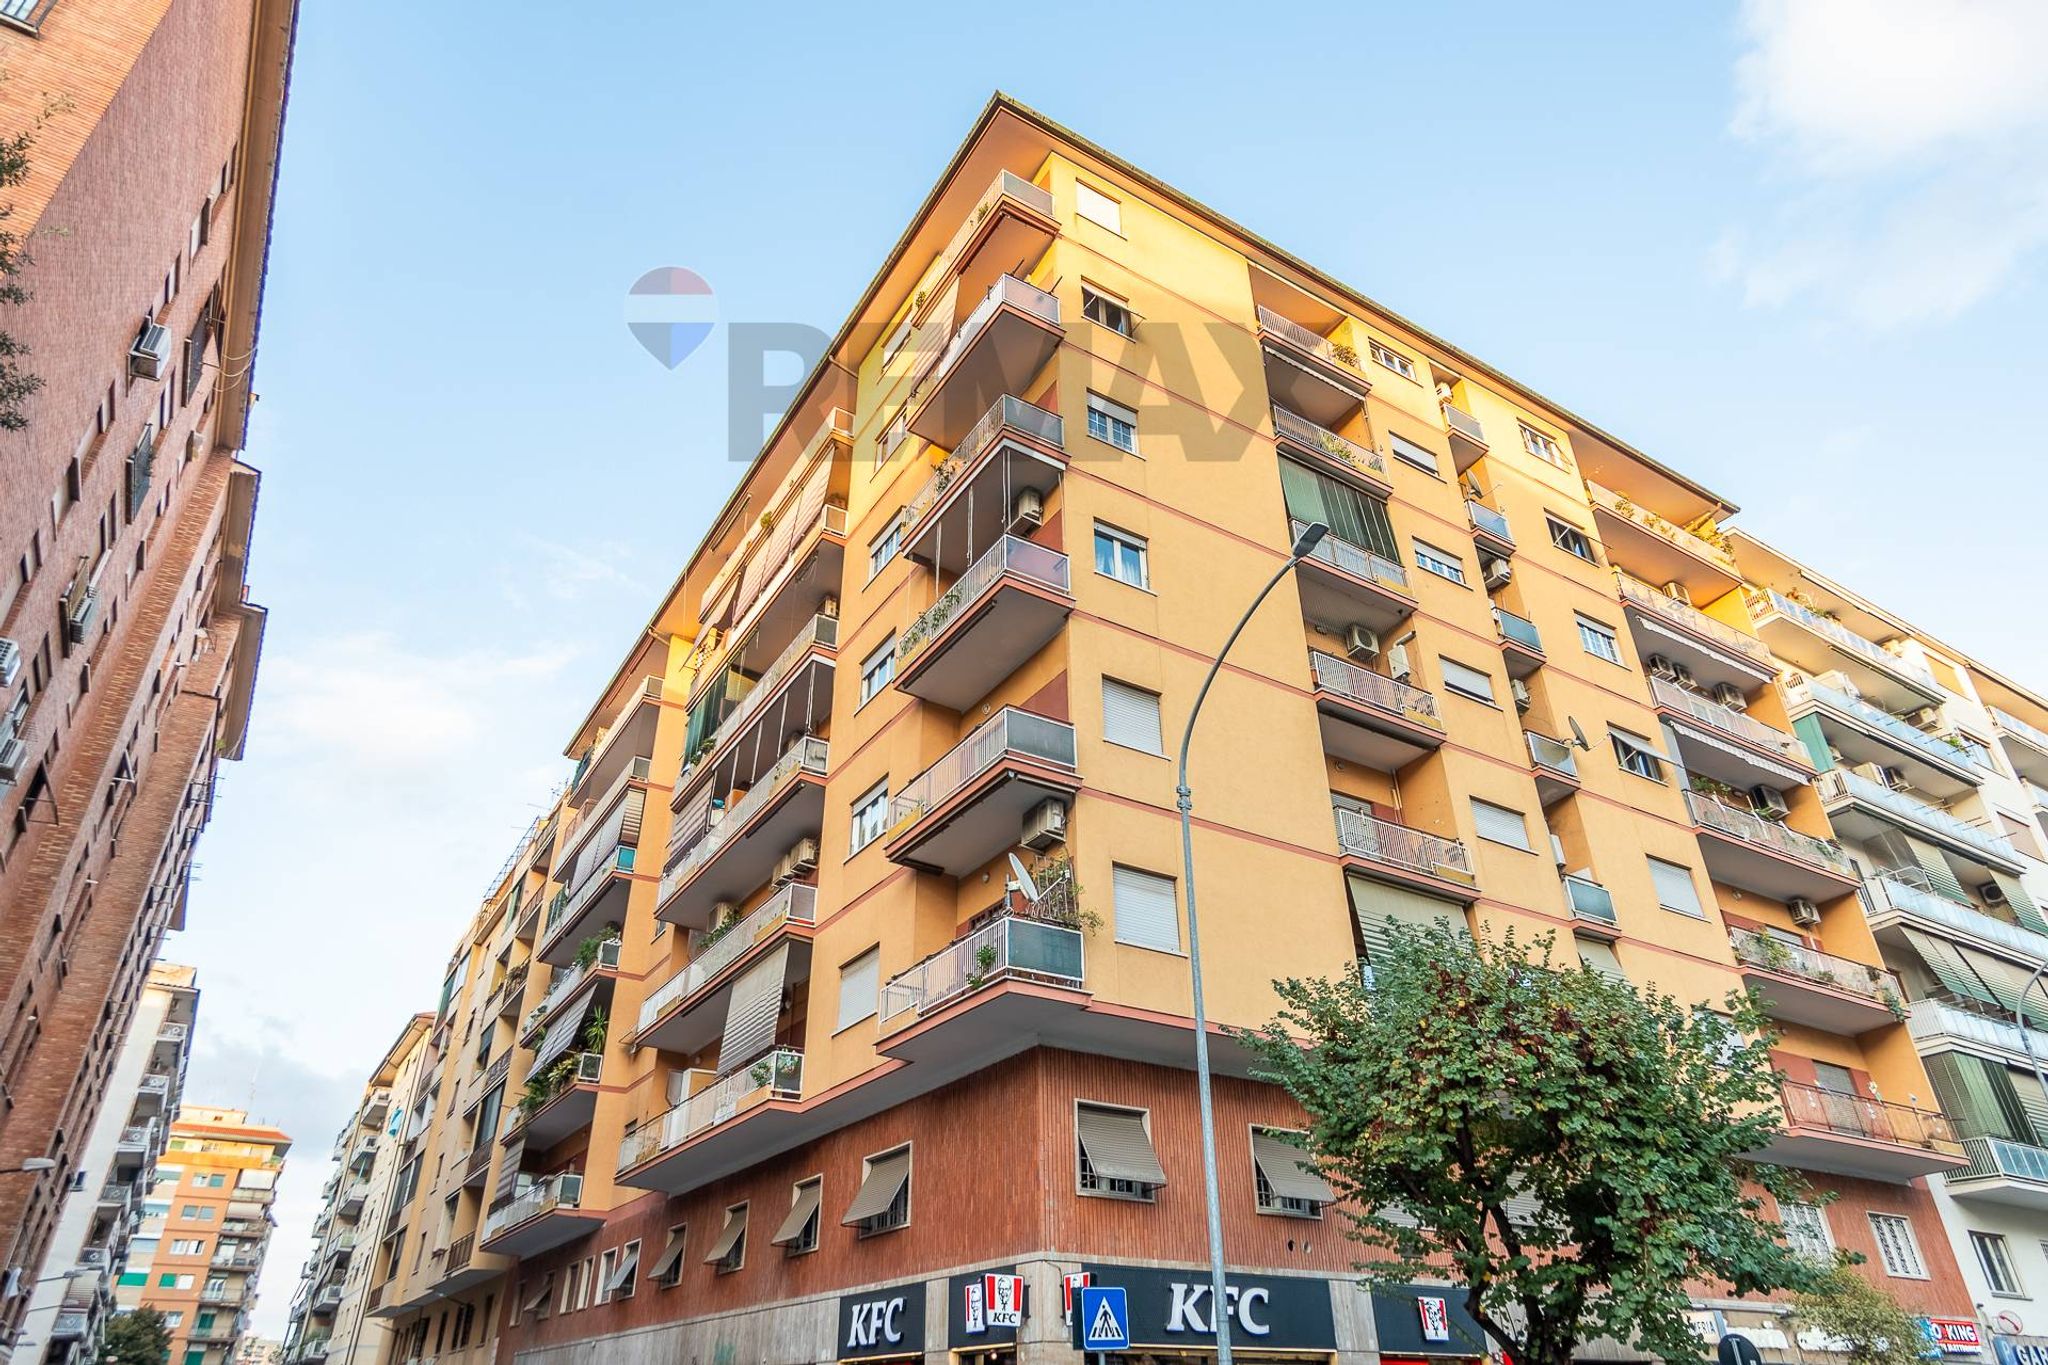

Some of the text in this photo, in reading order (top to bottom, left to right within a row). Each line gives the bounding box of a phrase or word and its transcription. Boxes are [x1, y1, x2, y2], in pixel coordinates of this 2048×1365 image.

[847, 1297, 904, 1348] KFC
[992, 1312, 1017, 1324] KFC
[1166, 1282, 1270, 1335] KFC
[1945, 1324, 1976, 1342] KING
